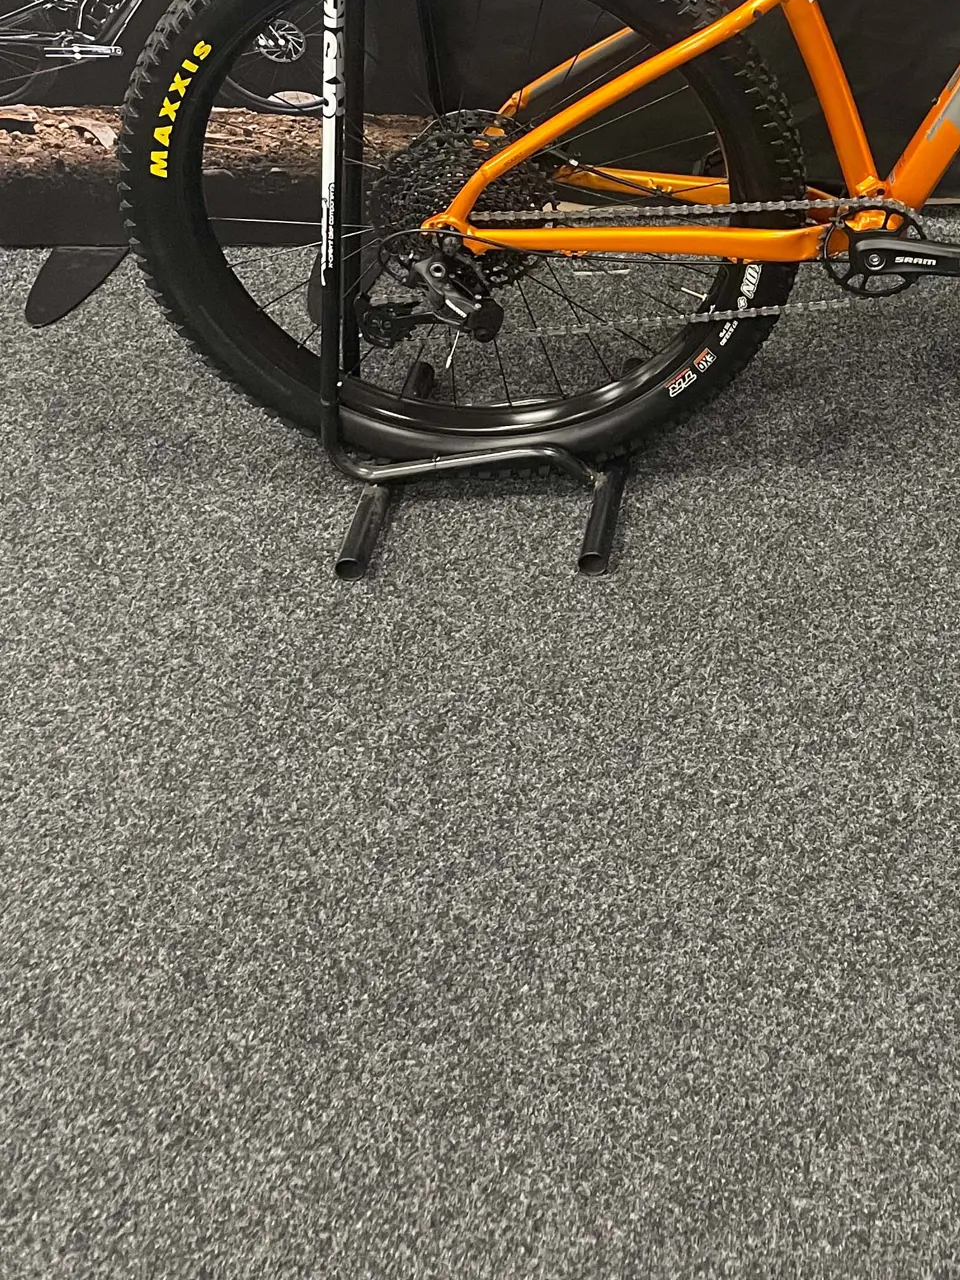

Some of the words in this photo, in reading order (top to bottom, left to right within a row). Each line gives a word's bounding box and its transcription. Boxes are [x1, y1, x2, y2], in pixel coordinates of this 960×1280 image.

[149, 39, 213, 178] MAXXIS
[894, 255, 937, 267] SRAM
[696, 350, 717, 373] EXO
